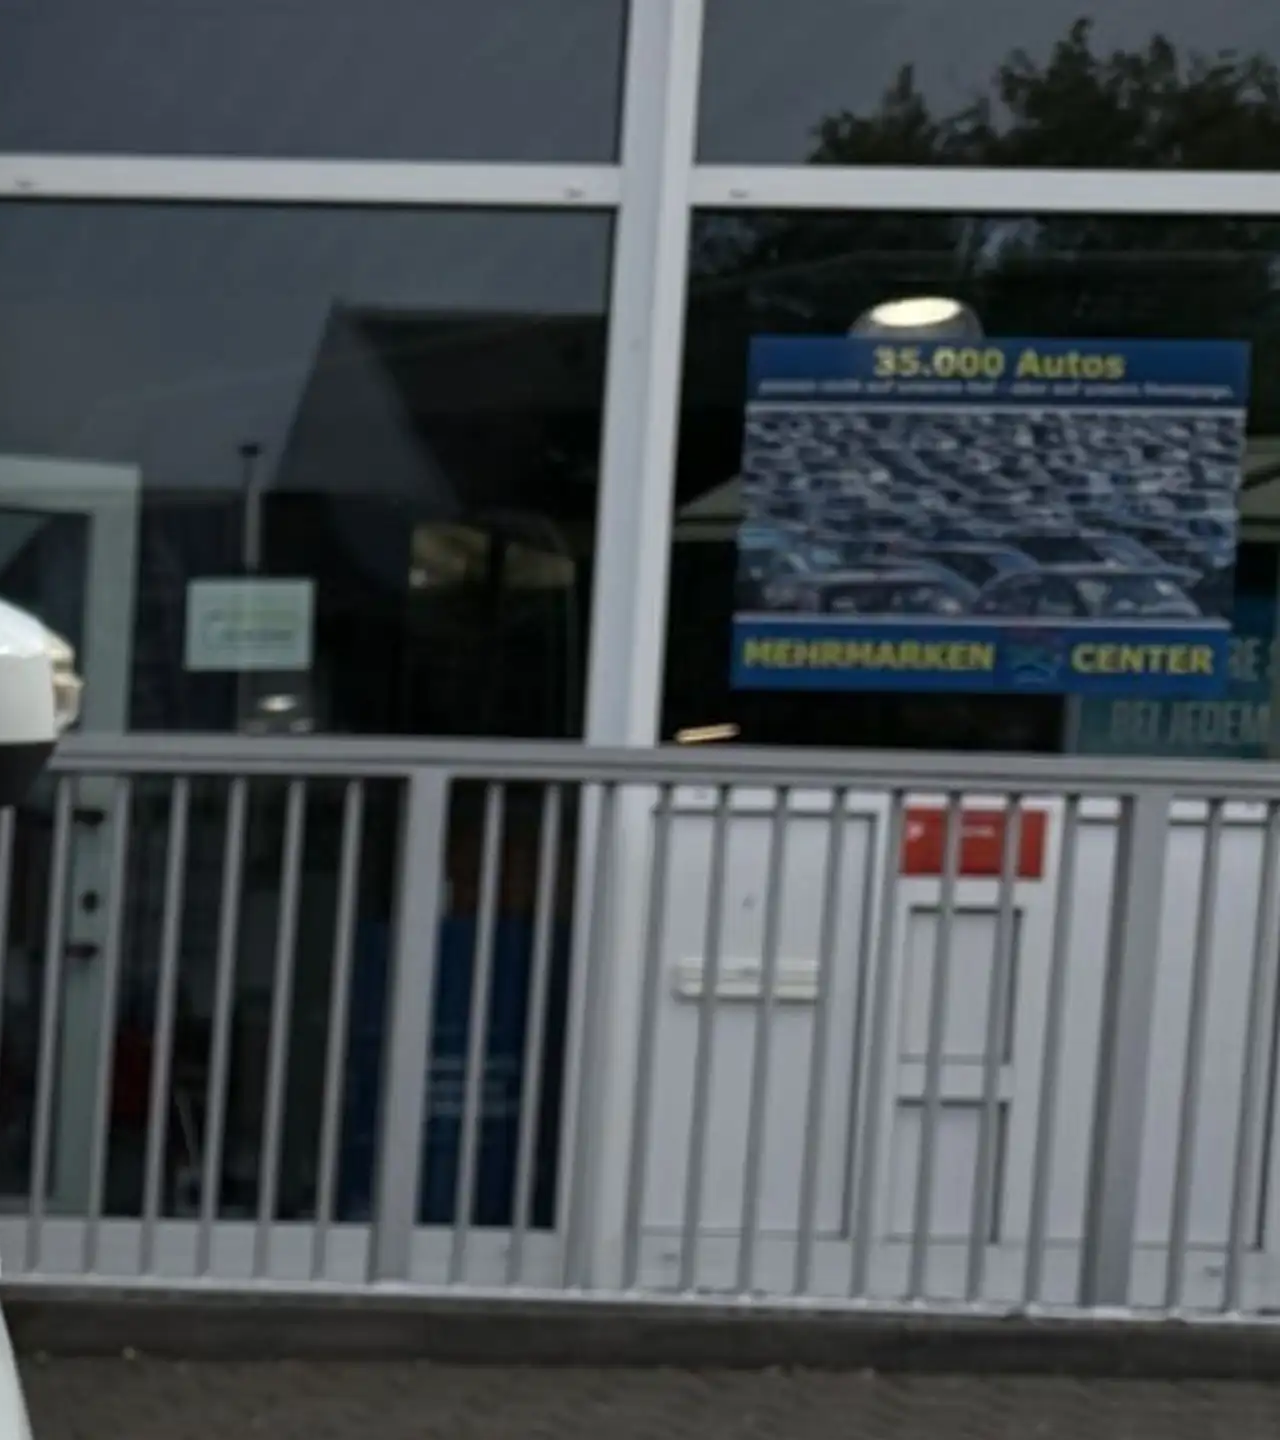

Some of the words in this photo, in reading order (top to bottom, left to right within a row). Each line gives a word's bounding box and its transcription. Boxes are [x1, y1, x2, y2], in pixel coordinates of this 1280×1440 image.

[872, 345, 1005, 378] 35.000
[1016, 348, 1125, 379] Autos
[743, 636, 995, 671] MEHRMARKEN
[1071, 642, 1214, 675] CENTER
